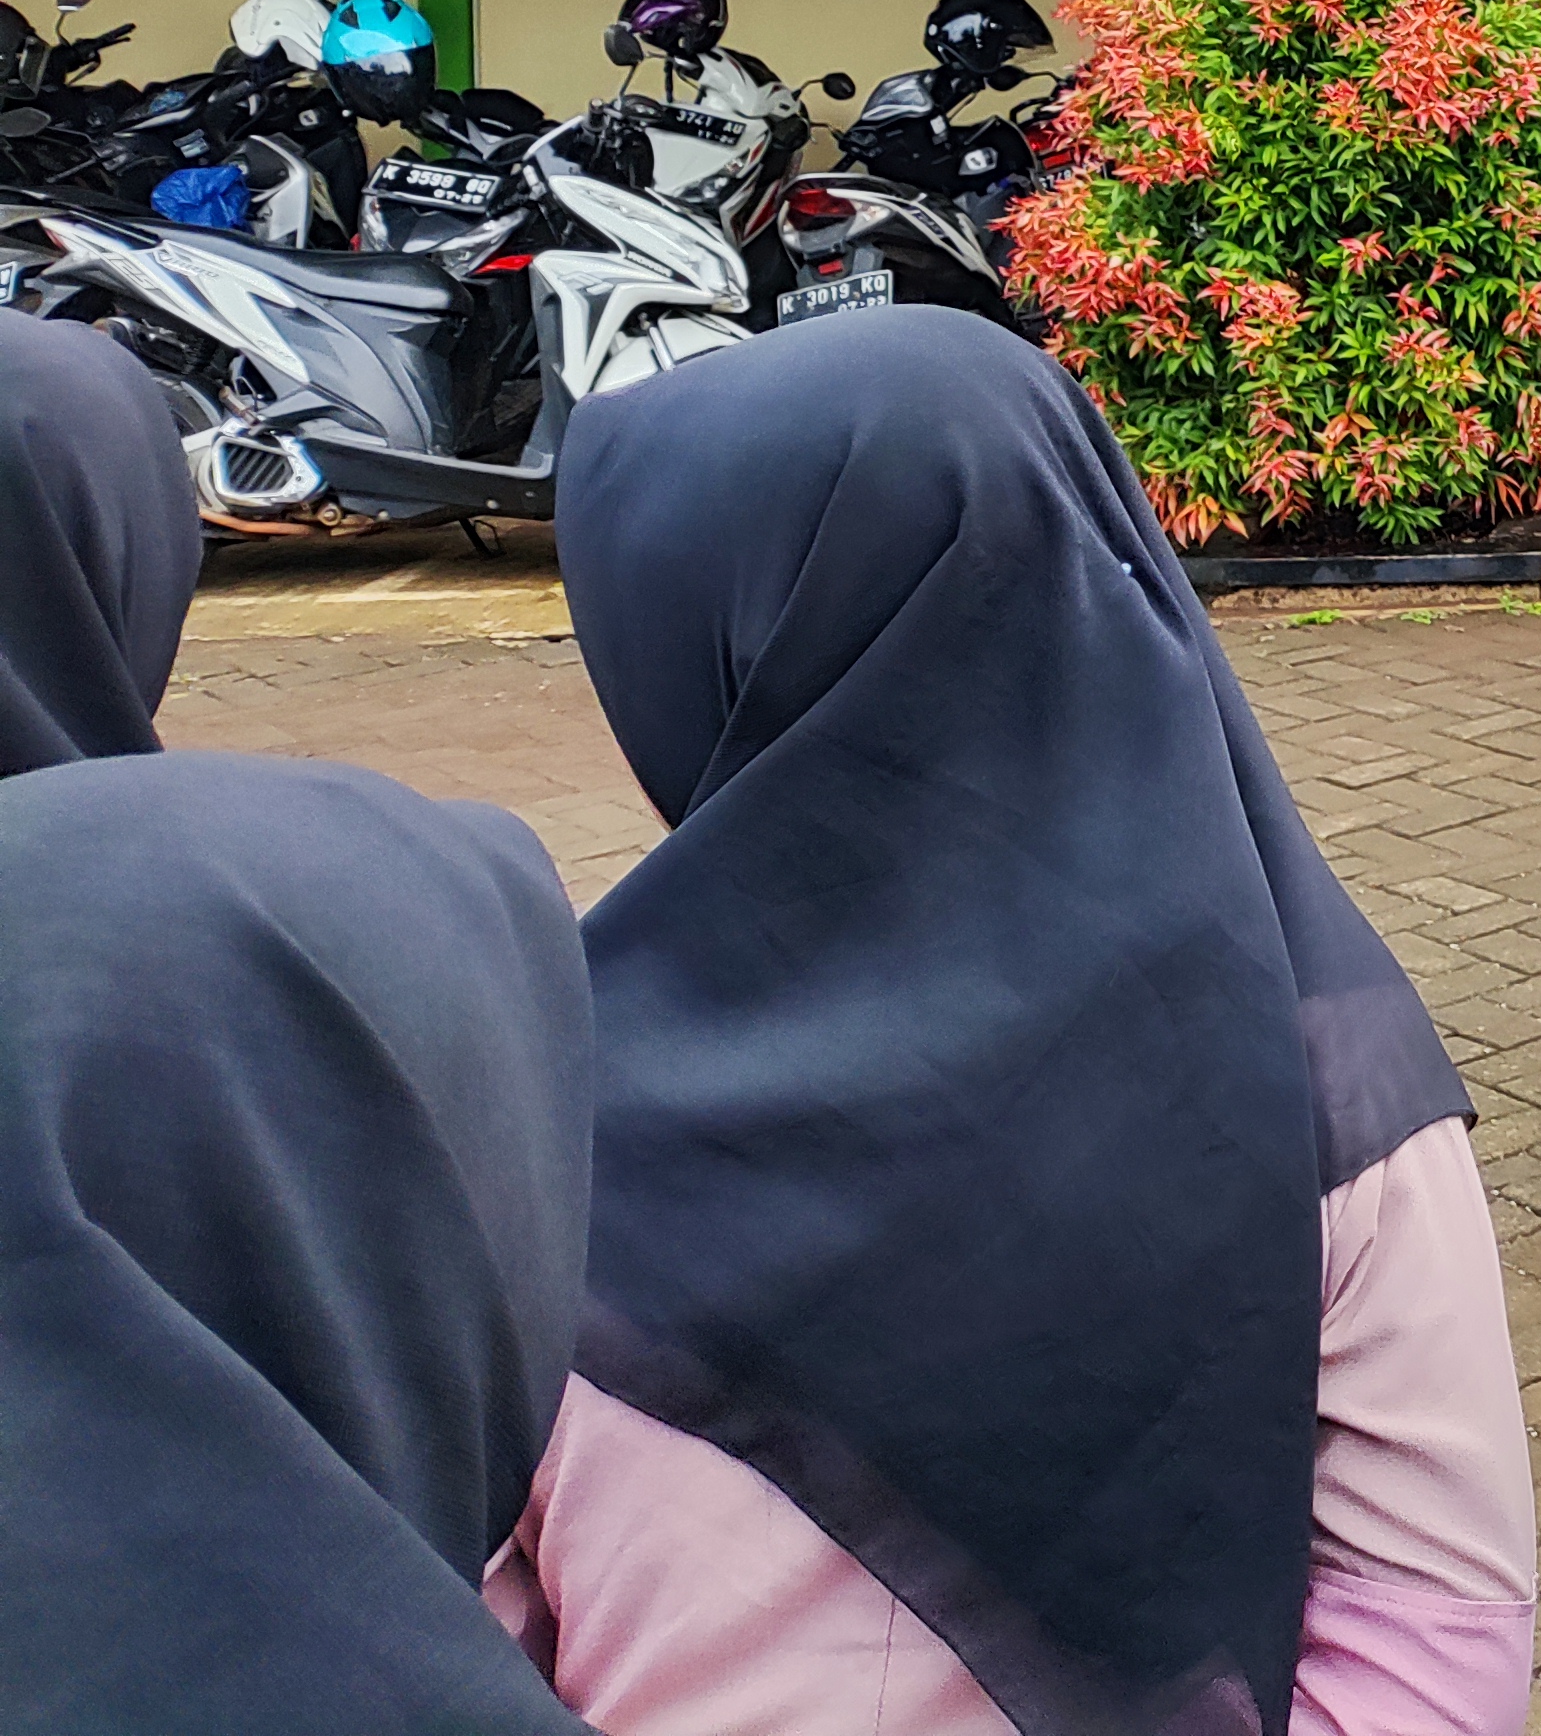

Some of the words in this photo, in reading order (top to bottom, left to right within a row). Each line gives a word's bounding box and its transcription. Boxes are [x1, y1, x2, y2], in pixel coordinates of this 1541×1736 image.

[383, 164, 400, 180] K
[782, 295, 794, 314] K
[807, 283, 850, 306] 3019
